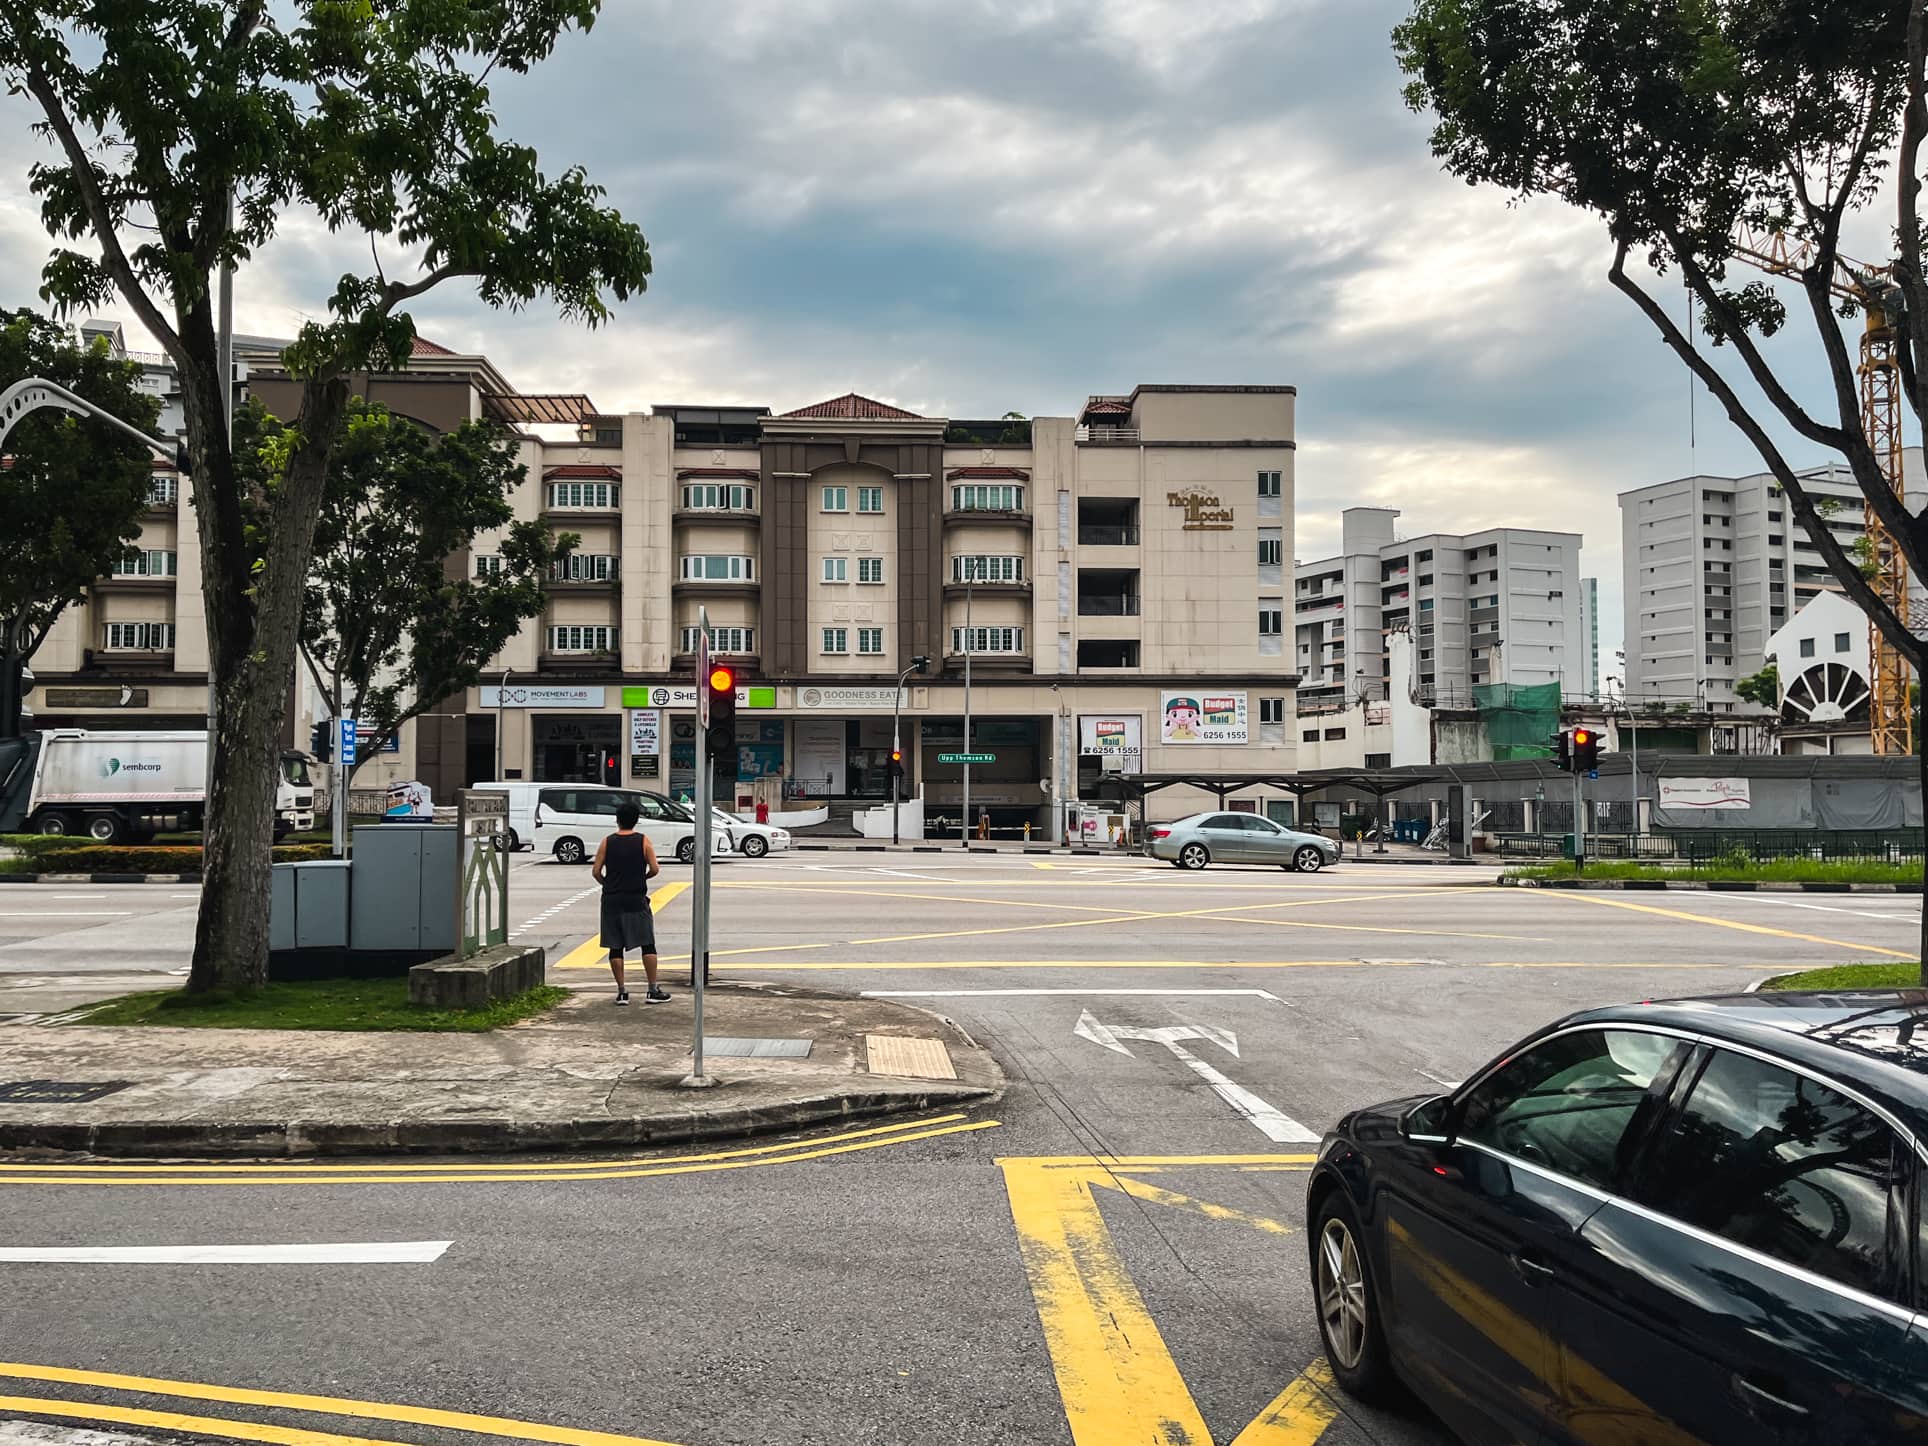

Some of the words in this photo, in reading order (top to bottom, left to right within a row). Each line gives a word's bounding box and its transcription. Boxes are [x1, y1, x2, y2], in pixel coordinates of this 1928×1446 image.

[823, 690, 878, 699] GOODNESS
[1204, 699, 1234, 709] Budget
[1209, 714, 1229, 724] Maid
[1203, 731, 1224, 739] 6256
[1227, 731, 1247, 739] 1555
[1102, 737, 1120, 746] Maid
[1092, 746, 1114, 754] 6256
[1118, 746, 1139, 754] 1555
[122, 762, 162, 772] sembcorp
